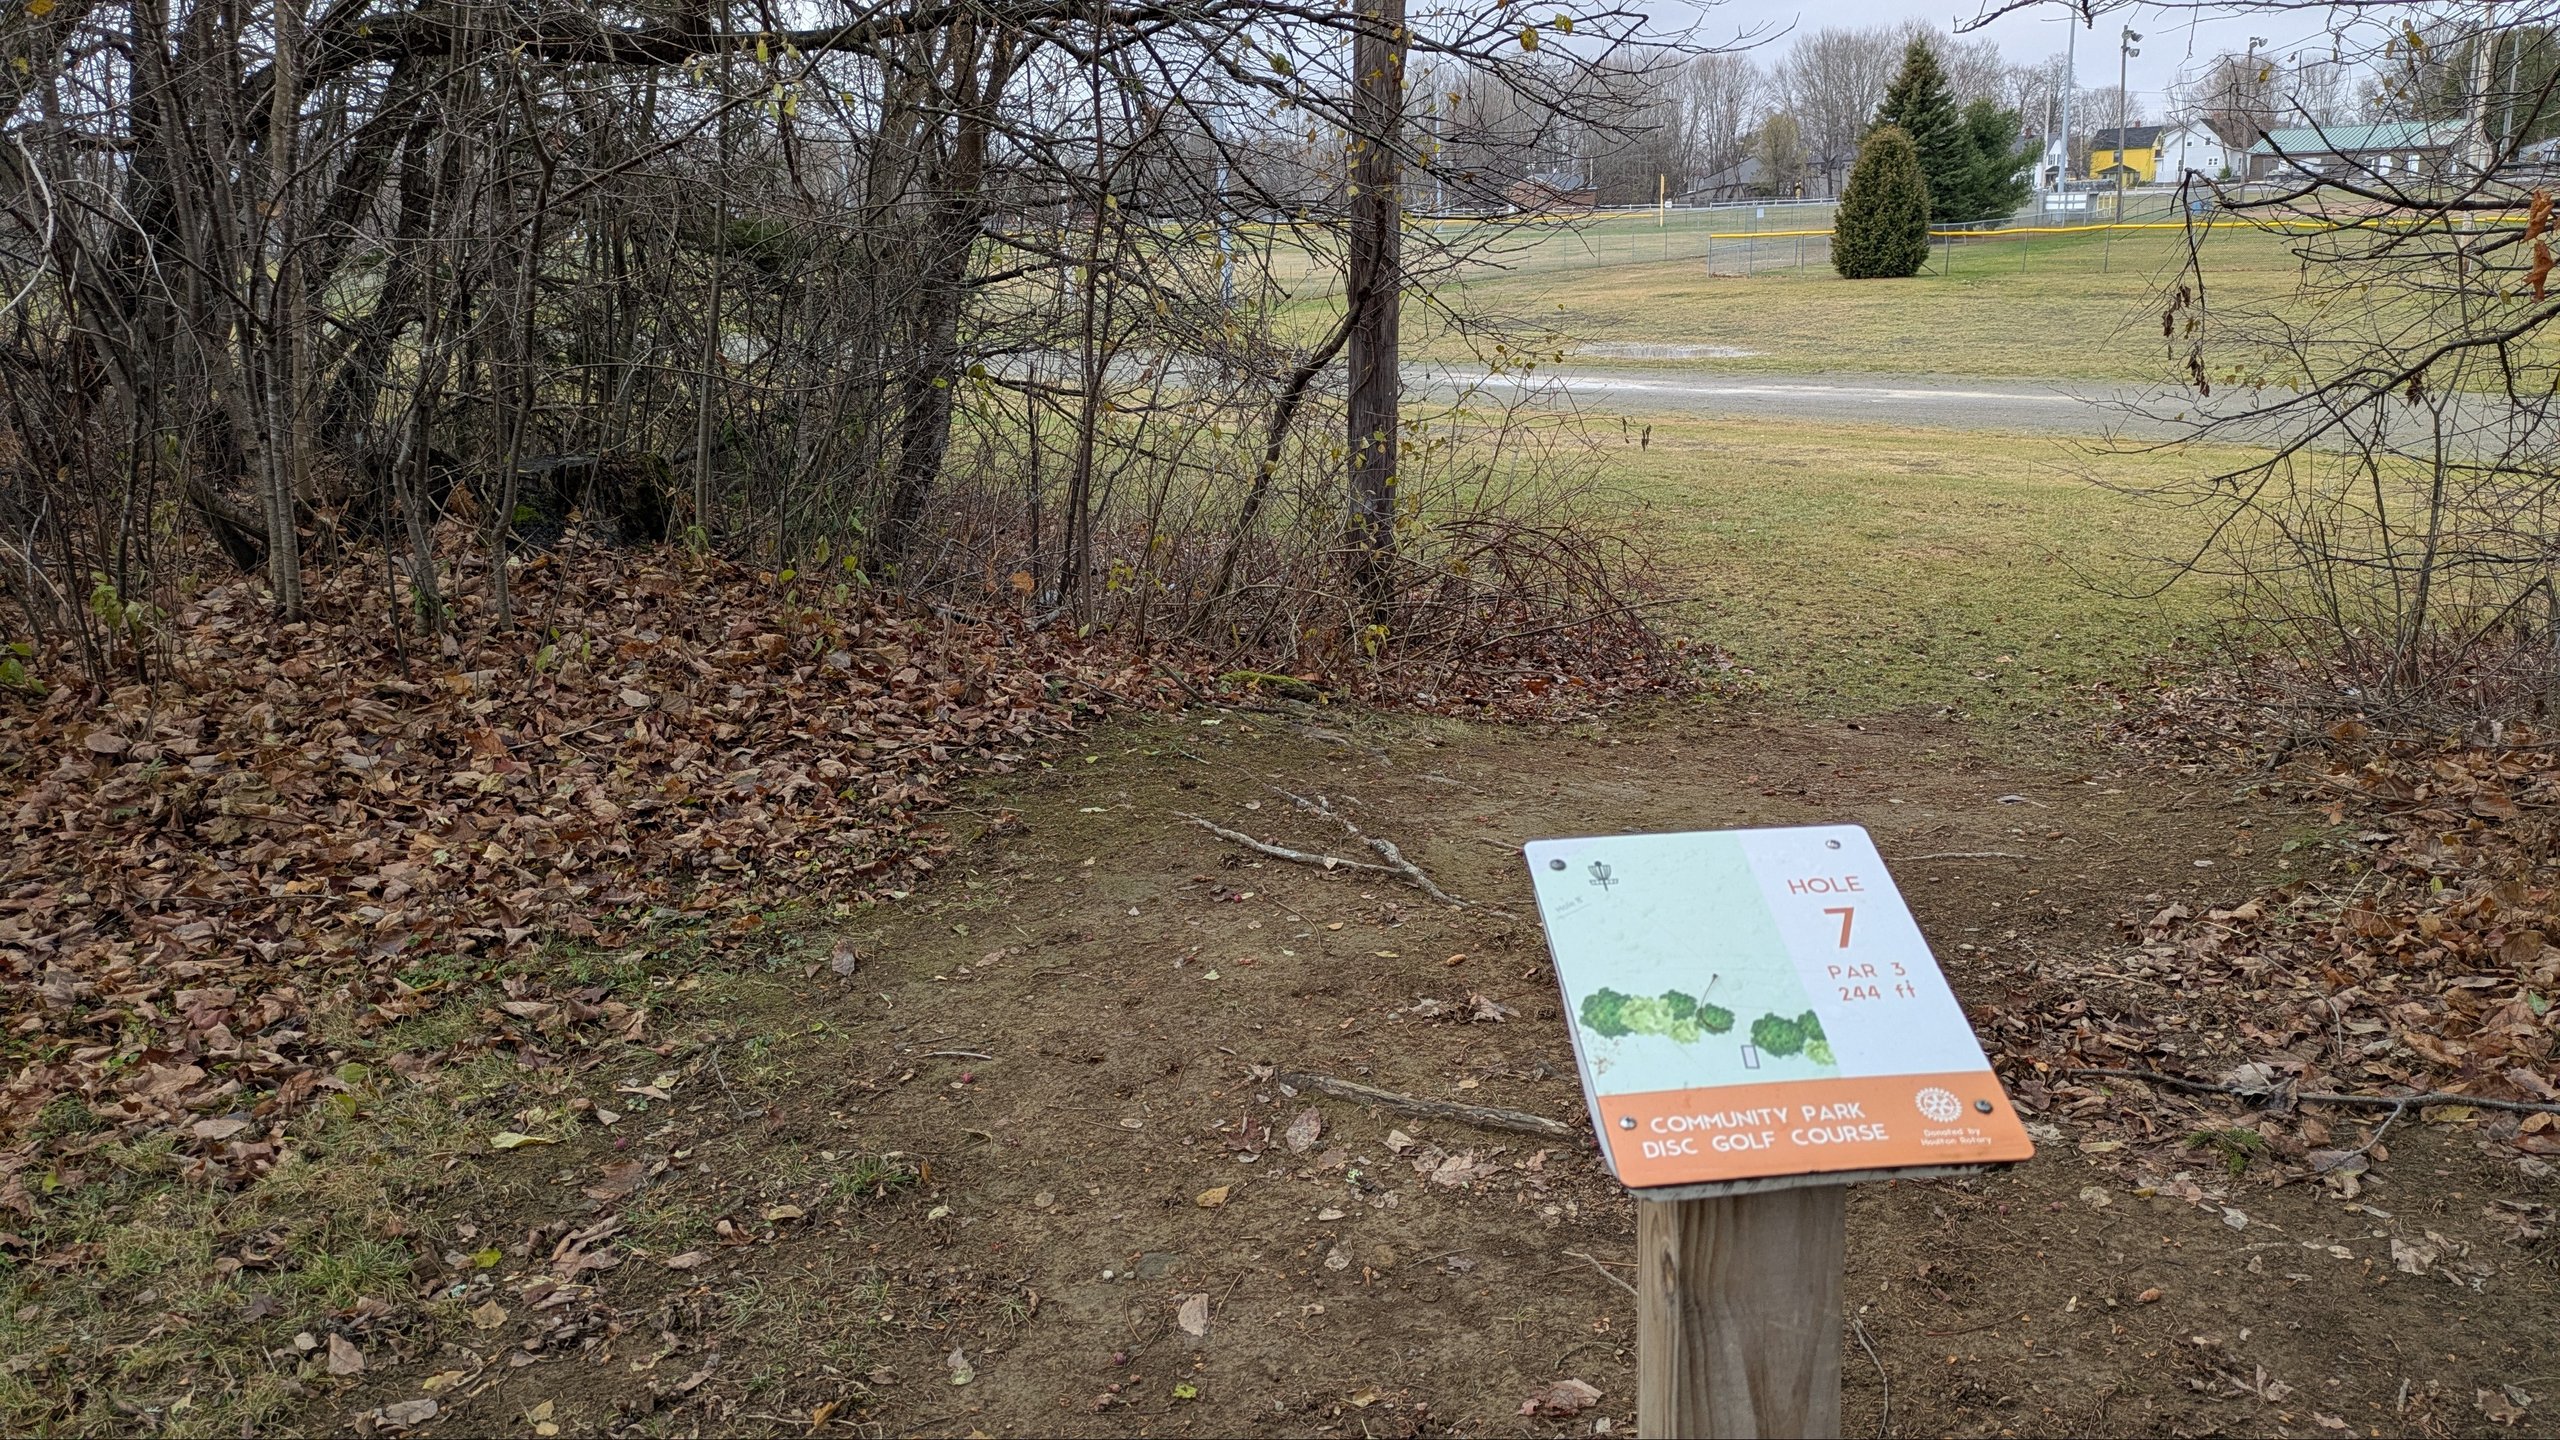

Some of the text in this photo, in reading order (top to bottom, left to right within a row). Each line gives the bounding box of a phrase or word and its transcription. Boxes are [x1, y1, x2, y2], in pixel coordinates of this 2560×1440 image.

[1787, 876, 1864, 894] HOLE
[1823, 906, 1854, 949] 7
[1827, 962, 1906, 980] PAR 3
[1838, 979, 1915, 1001] 244 ft
[1650, 1102, 1866, 1134] COMMUNITY PARK
[1642, 1123, 1890, 1159] DISC GOLF COURSE
[1923, 1127, 1981, 1137] Donated by
[1959, 1136, 1992, 1145] Rotary
